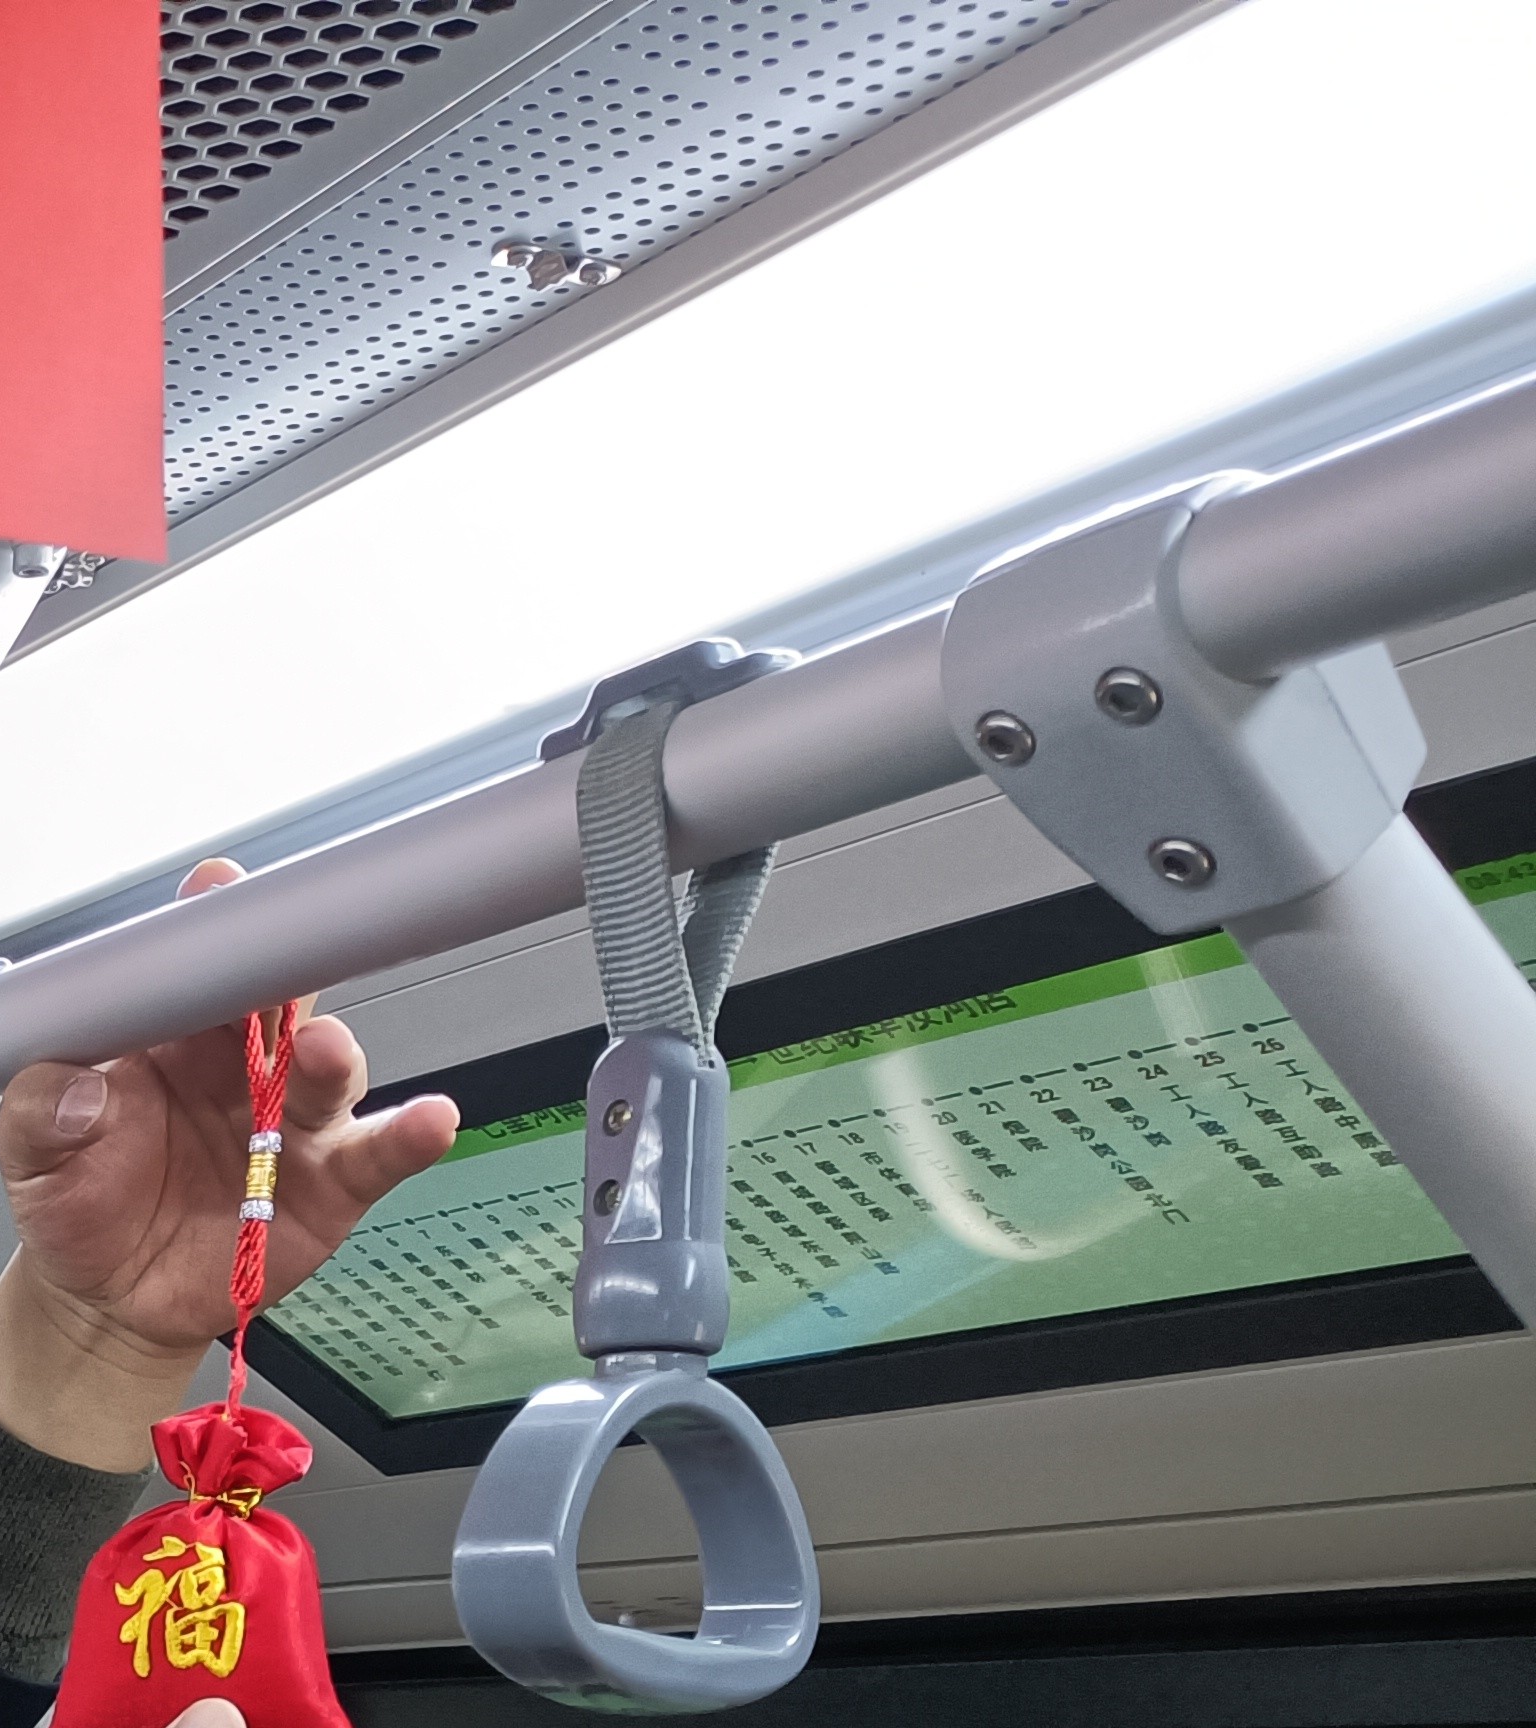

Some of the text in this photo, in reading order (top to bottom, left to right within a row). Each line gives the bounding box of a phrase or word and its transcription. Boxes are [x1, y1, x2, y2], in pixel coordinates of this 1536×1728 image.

[1251, 1037, 1286, 1055] 26
[1193, 1050, 1226, 1068] 25
[1137, 1063, 1170, 1080] 24
[1082, 1076, 1114, 1093] 23
[1029, 1088, 1062, 1104] 22
[978, 1100, 1007, 1116] 21
[931, 1110, 958, 1126] 20
[837, 1131, 866, 1146] 18
[793, 1141, 818, 1156] 17
[750, 1151, 777, 1166] 16
[553, 1195, 577, 1211] 11
[517, 1205, 541, 1218] 10
[115, 1535, 246, 1678] 福
